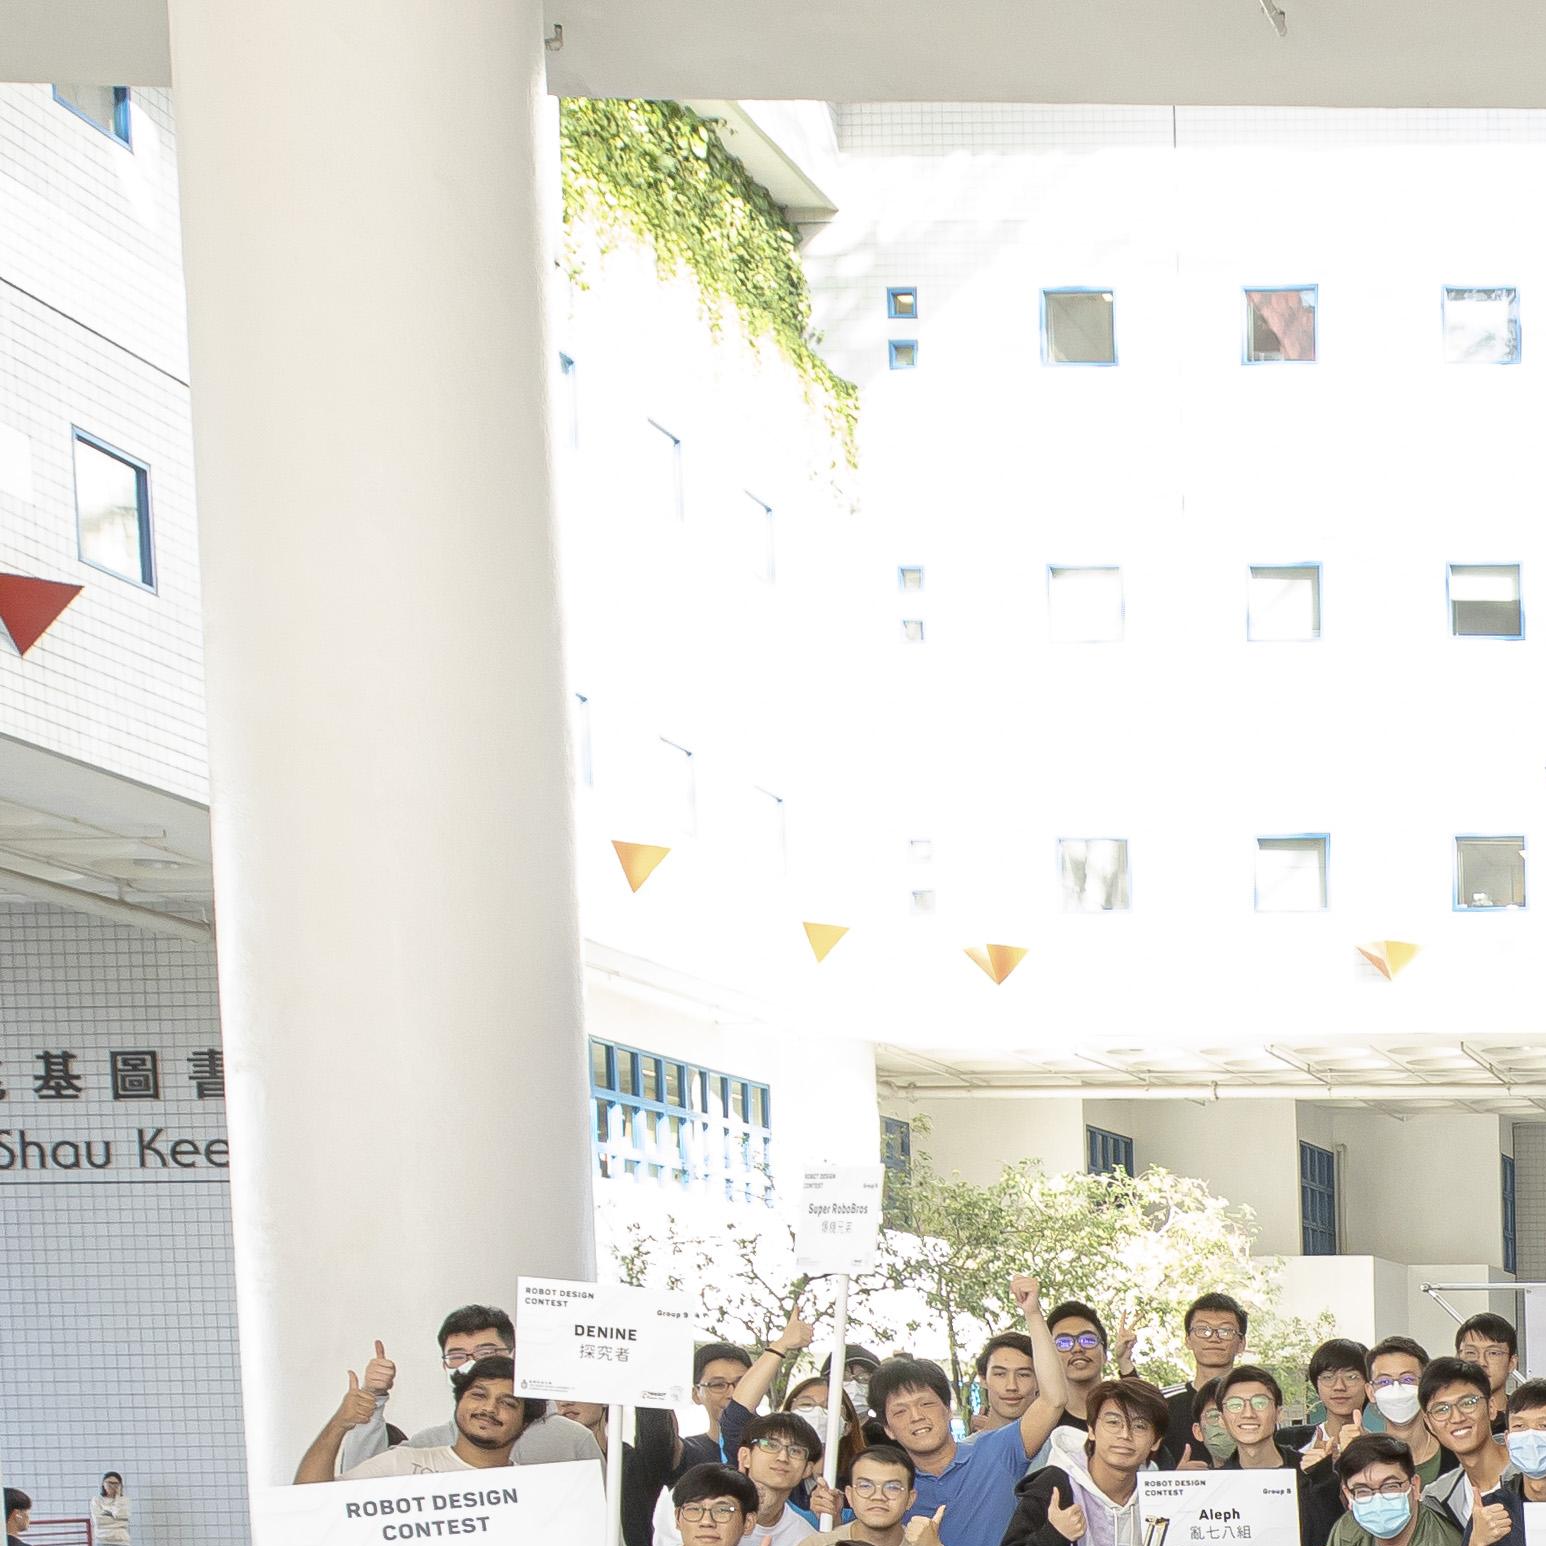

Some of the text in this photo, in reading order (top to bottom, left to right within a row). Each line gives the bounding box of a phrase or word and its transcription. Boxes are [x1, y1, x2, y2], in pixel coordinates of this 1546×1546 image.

[0, 1048, 225, 1101] 基圖書
[0, 1128, 229, 1169] Shau Kee
[809, 1203, 830, 1216] Super
[525, 1287, 595, 1300] ROBOT DESIGN
[525, 1298, 568, 1307] CONTEST
[574, 1324, 638, 1341] DENINE
[579, 1344, 630, 1362] 探究者
[346, 1489, 517, 1518] ROBOT DESIGN
[1199, 1508, 1240, 1522] Aleph
[383, 1516, 489, 1540] CONTEST
[1190, 1525, 1252, 1540] 亂七八組
